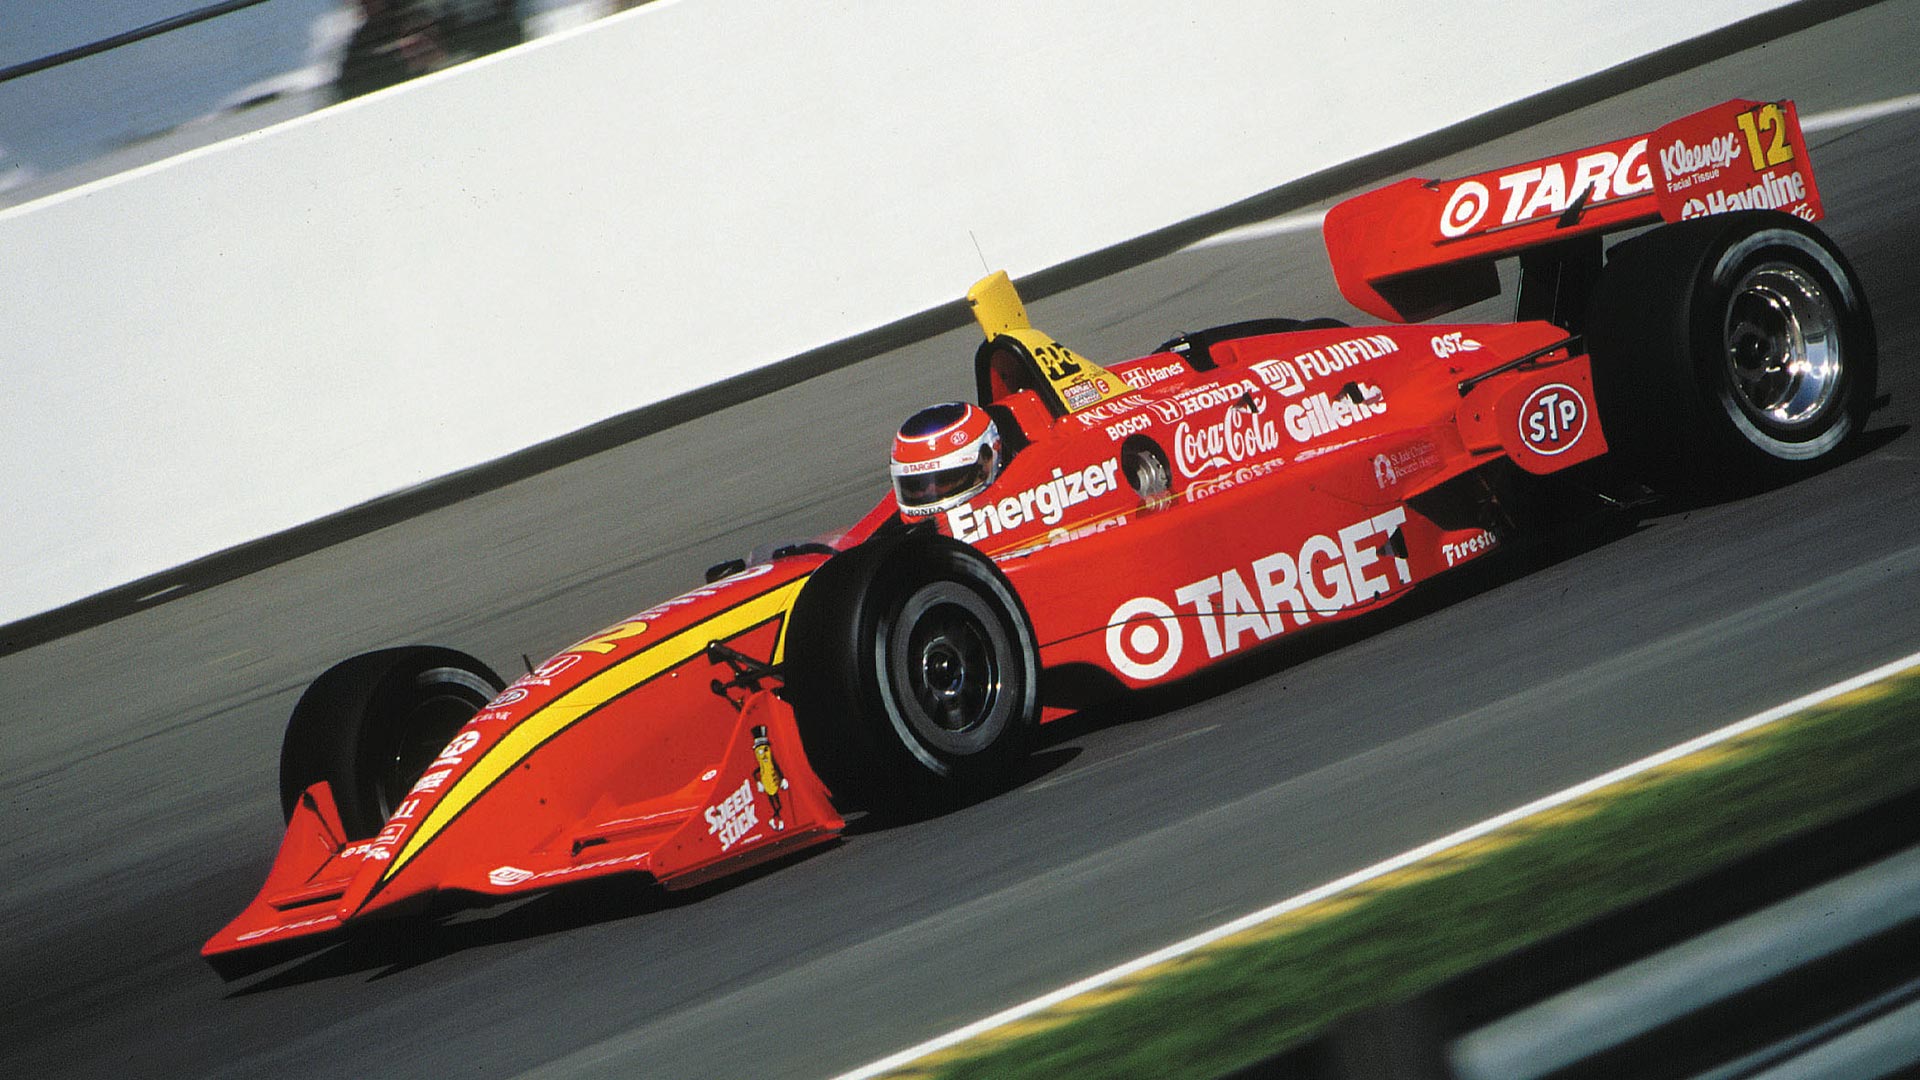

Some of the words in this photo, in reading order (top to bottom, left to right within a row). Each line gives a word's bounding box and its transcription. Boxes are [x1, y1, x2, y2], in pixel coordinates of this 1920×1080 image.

[1737, 103, 1795, 171] 12
[1660, 132, 1741, 182] Kleenex
[1666, 177, 1692, 194] Facial
[1691, 169, 1720, 186] Tissue
[1295, 335, 1400, 381] FUJIFILM
[1431, 332, 1463, 358] QST
[1148, 362, 1185, 384] Hanes
[1179, 379, 1261, 415] HONDA
[1105, 413, 1152, 441] BOSCH
[1529, 393, 1578, 442] STP
[909, 461, 941, 472] TARGET
[908, 506, 945, 516] HONDA
[947, 457, 1119, 545] Energizer
[1175, 506, 1413, 659] TARGET
